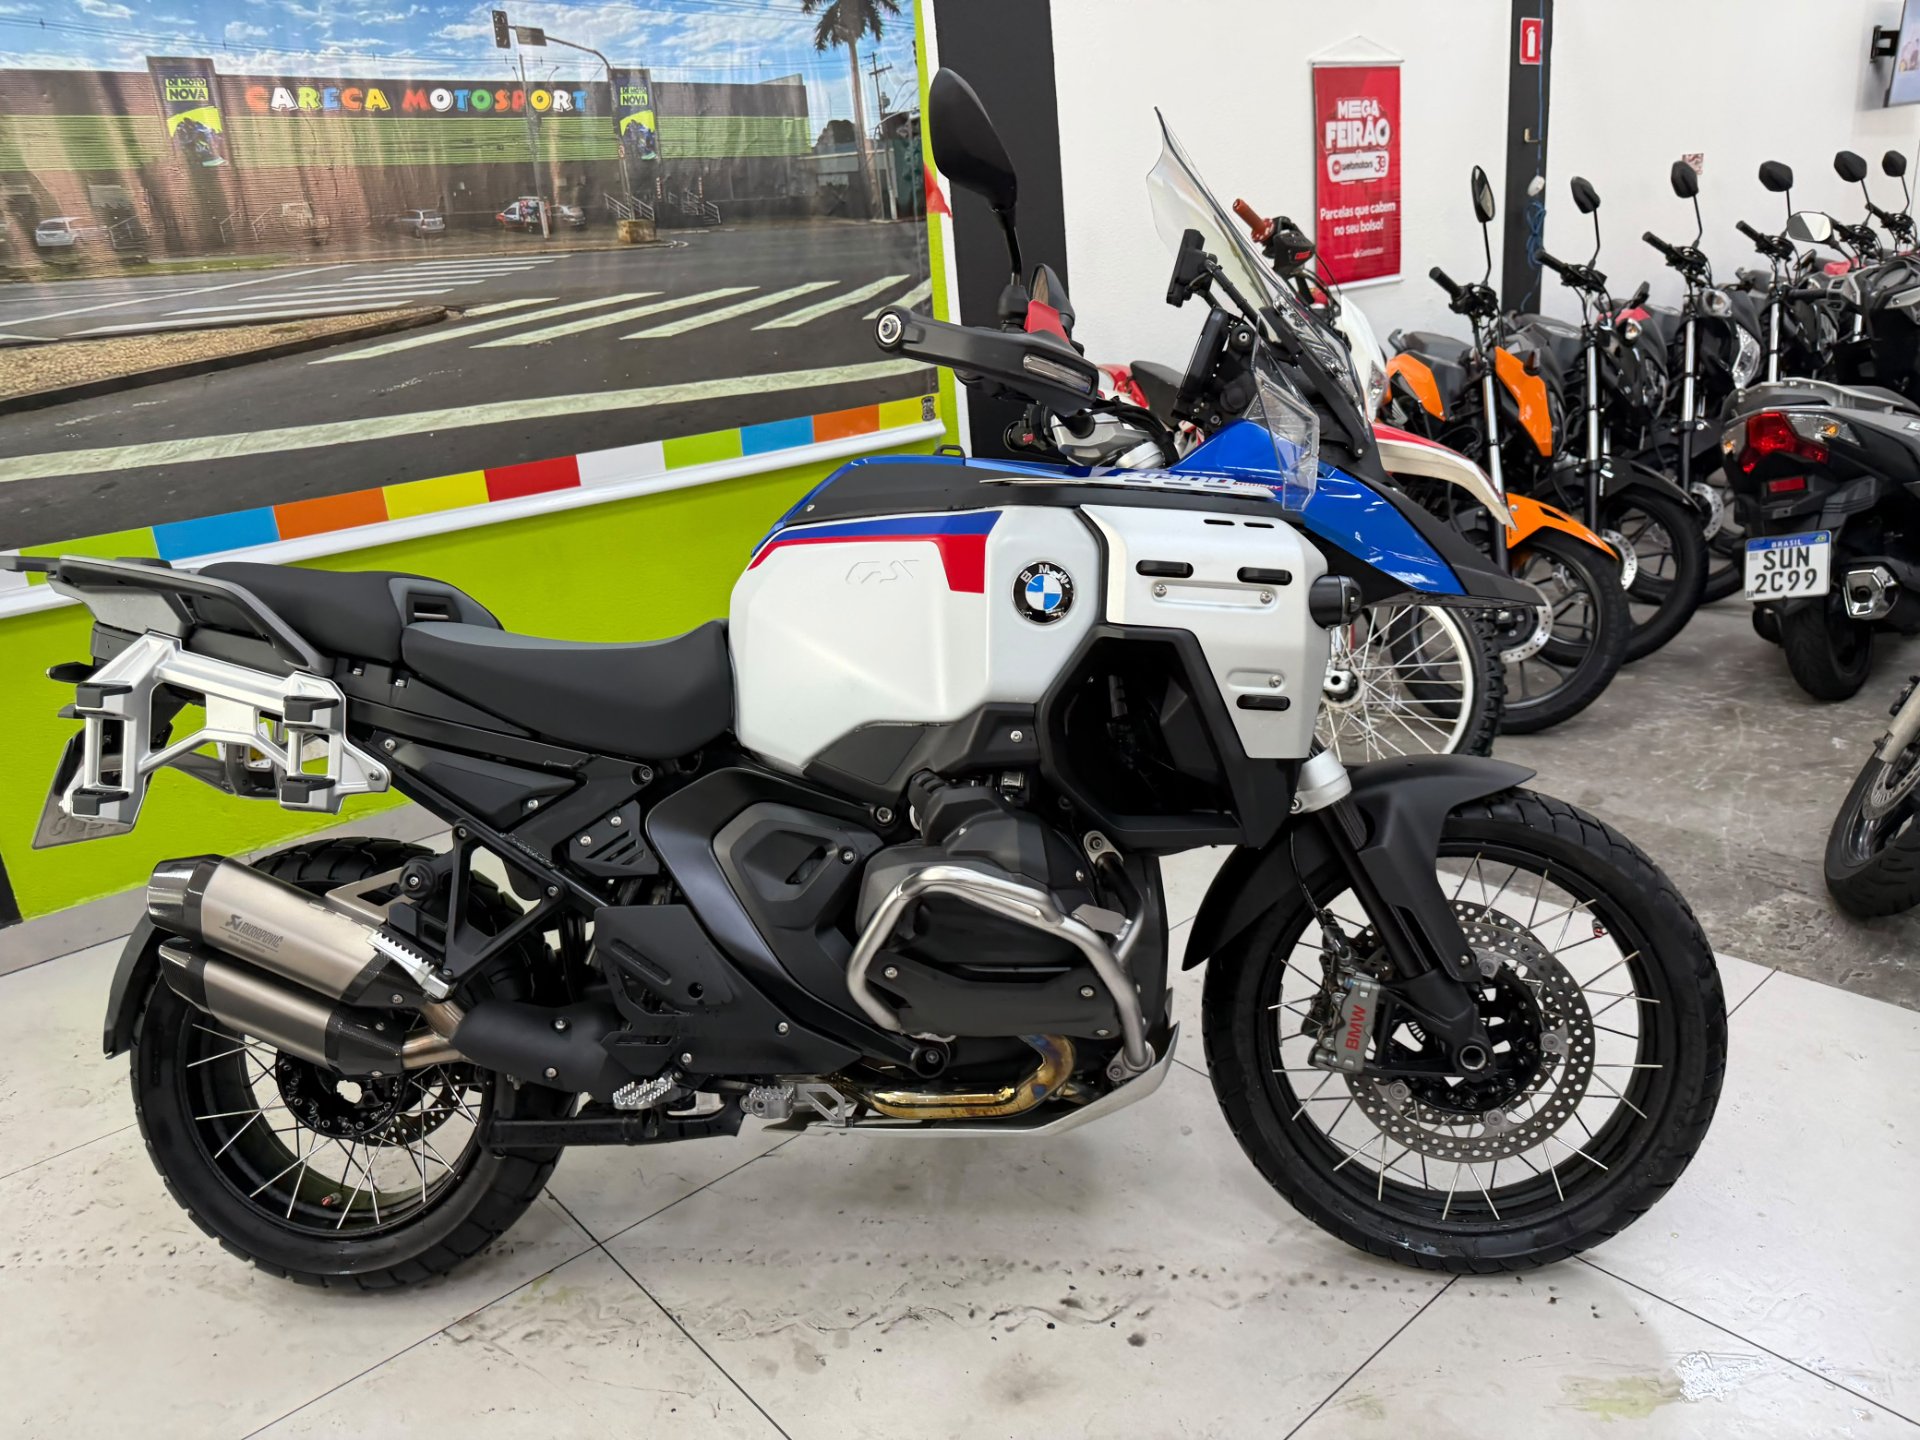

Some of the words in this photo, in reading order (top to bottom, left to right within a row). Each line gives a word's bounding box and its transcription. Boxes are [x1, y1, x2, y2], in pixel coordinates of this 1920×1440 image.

[168, 88, 207, 100] NOVA
[246, 86, 391, 112] CARECA
[402, 87, 588, 112] MOTOSPORT
[622, 95, 646, 105] NOVA
[1337, 99, 1380, 119] MEGA
[1325, 115, 1390, 149] FEIRÃO
[1320, 205, 1354, 221] Parcelas
[1354, 205, 1370, 219] que
[1370, 200, 1397, 214] cabem
[1333, 226, 1345, 236] no
[1345, 223, 1360, 235] seu
[1360, 217, 1384, 232] bolso!
[1771, 539, 1803, 548] BRASIL
[1763, 546, 1810, 571] SUN
[1020, 564, 1070, 584] BMW
[1754, 568, 1817, 594] 2C99
[1345, 1004, 1367, 1050] BMW
